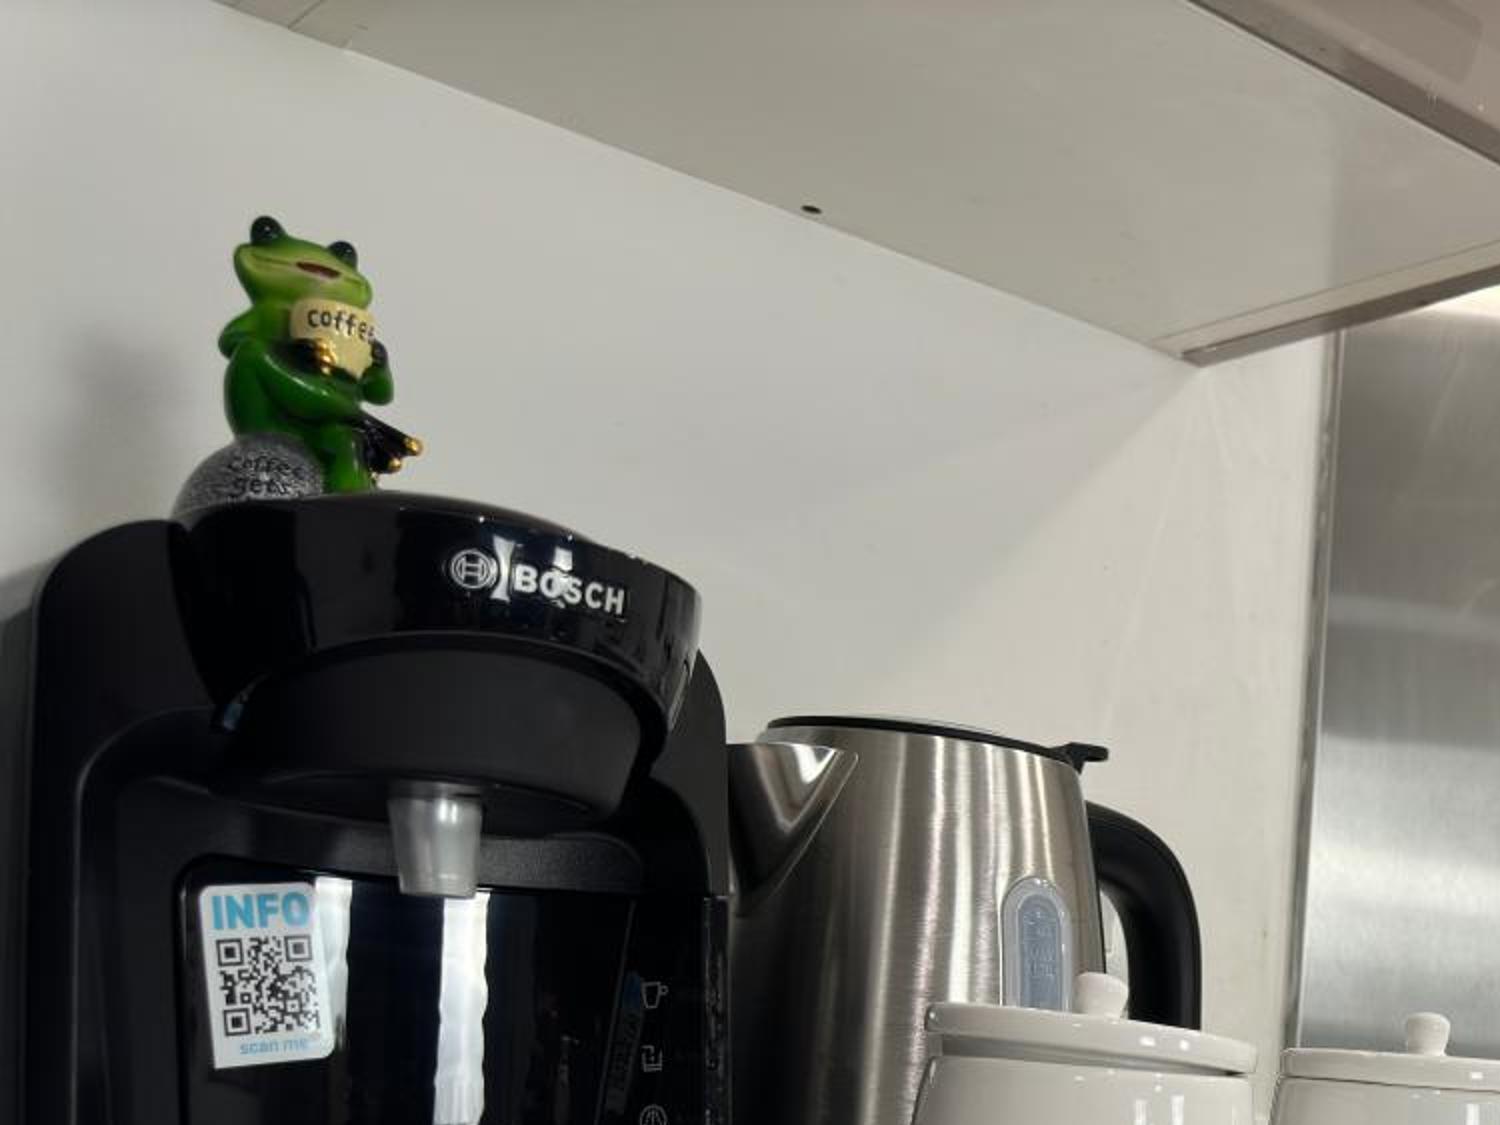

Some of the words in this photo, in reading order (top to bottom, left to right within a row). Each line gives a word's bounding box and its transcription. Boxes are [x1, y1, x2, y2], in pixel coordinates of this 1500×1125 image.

[513, 564, 625, 615] BOSCH
[211, 892, 310, 930] INFO
[240, 1040, 279, 1055] scan
[283, 1038, 312, 1052] me
